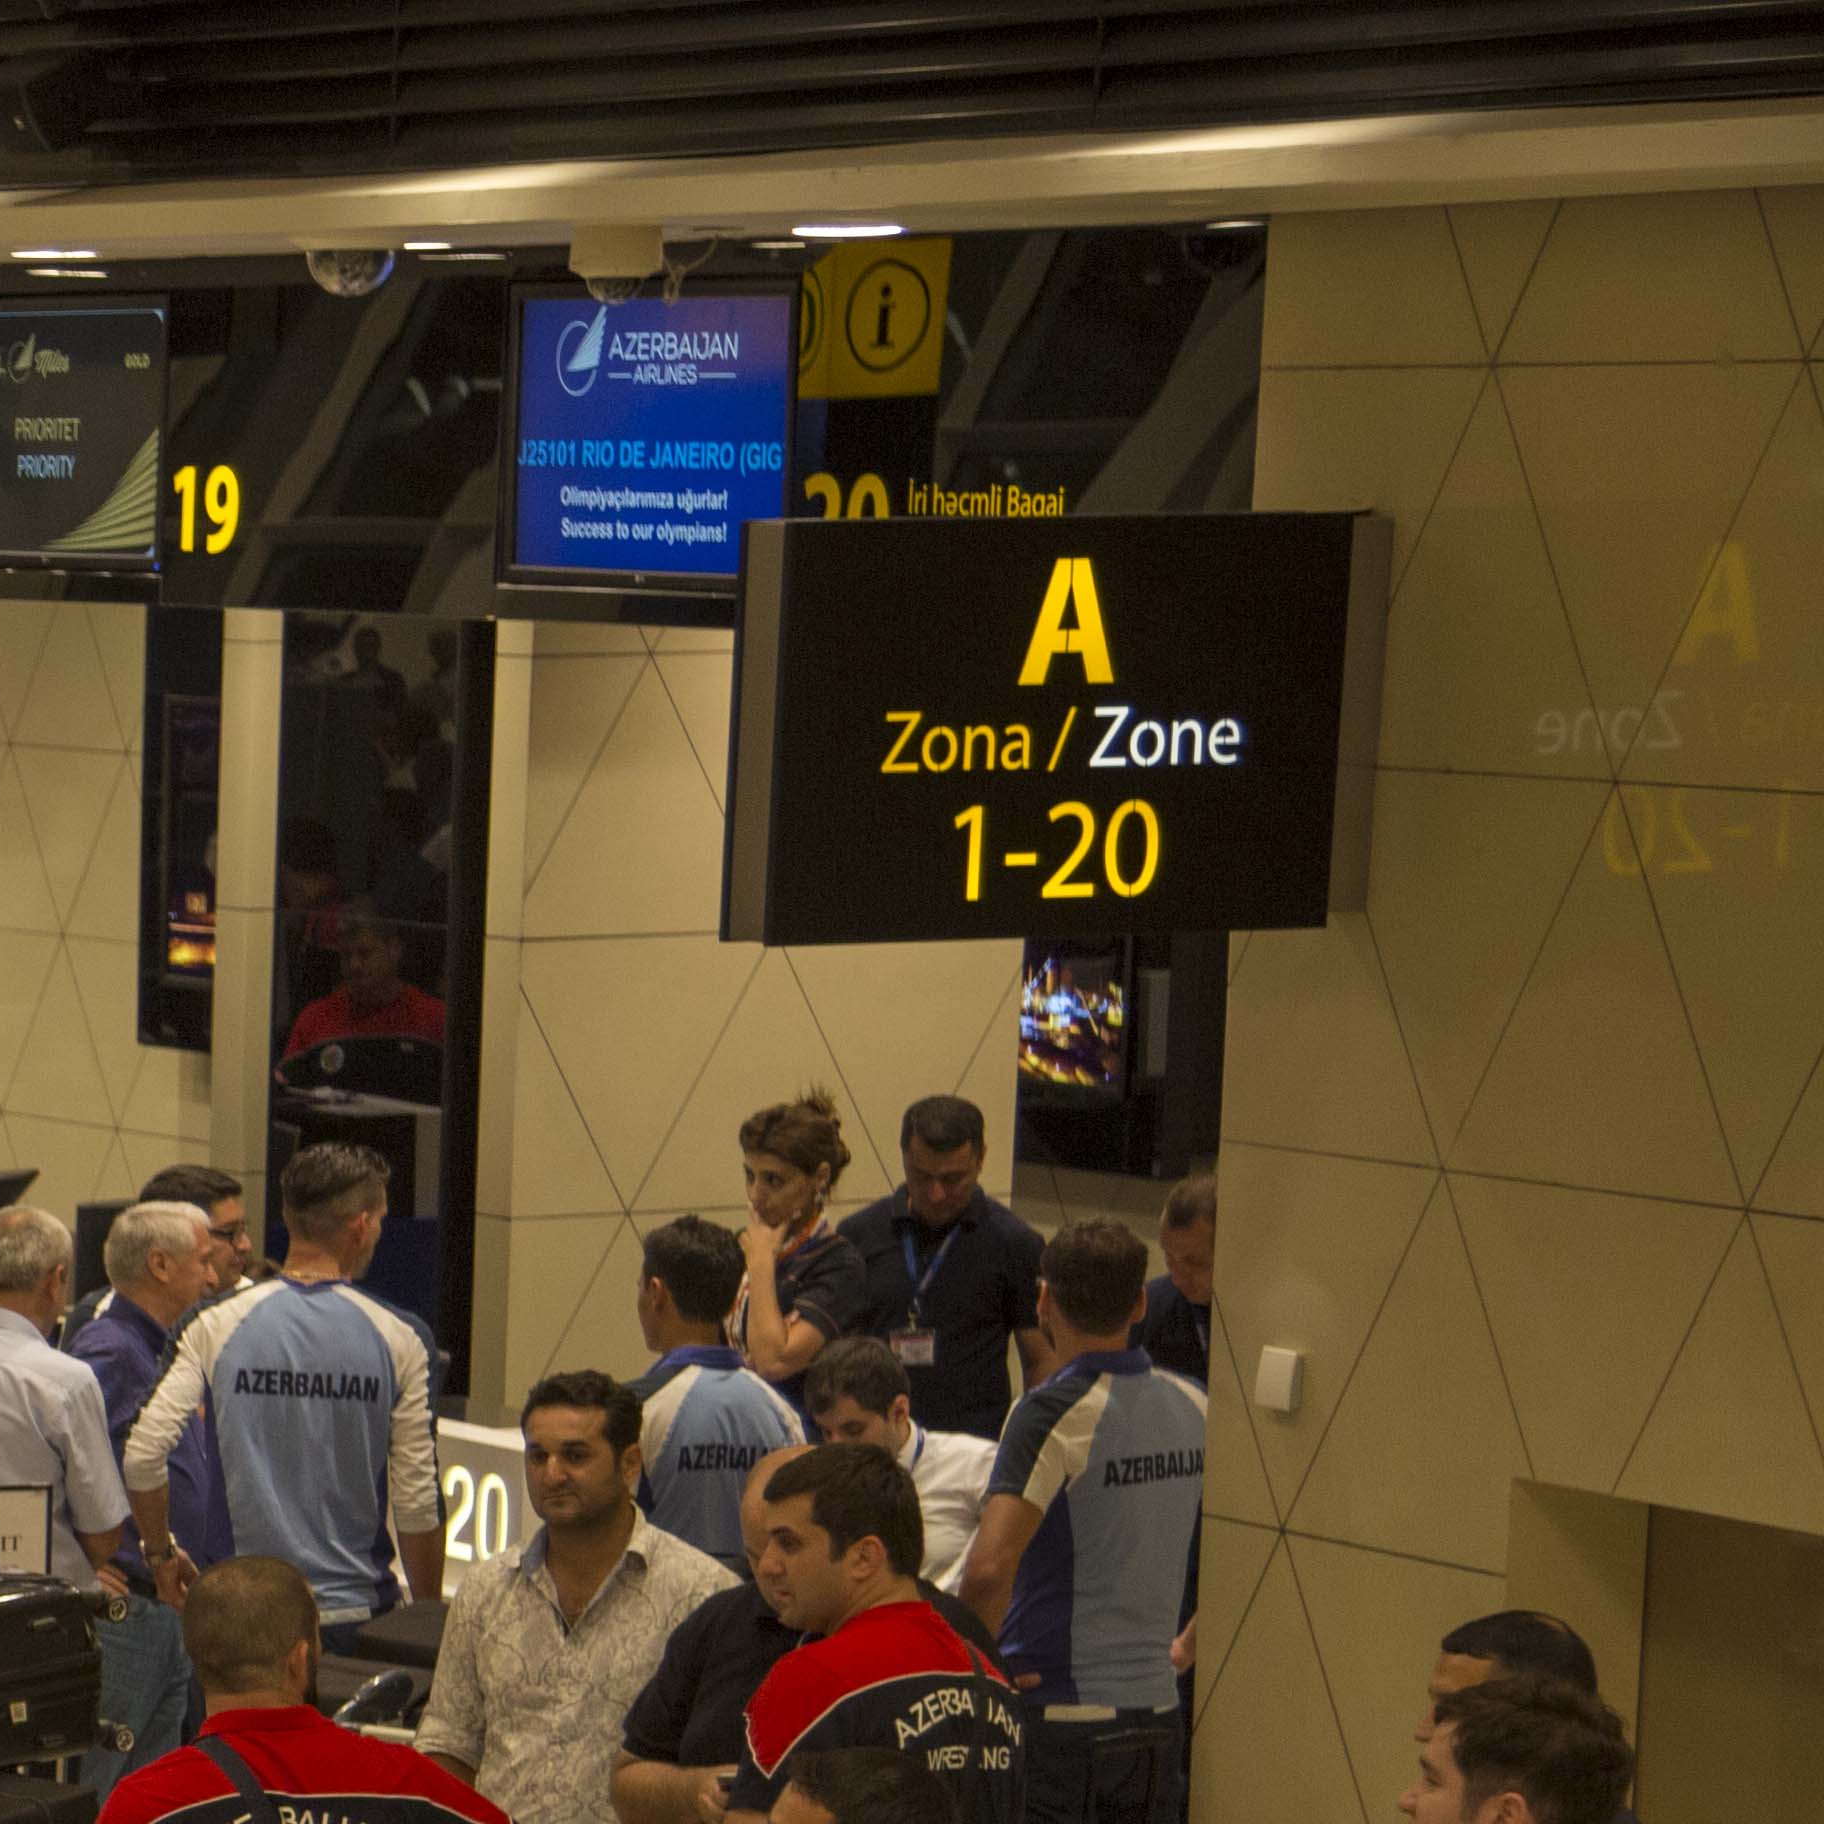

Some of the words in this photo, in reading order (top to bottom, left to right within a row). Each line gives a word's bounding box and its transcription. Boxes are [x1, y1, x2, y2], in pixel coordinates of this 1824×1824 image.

[608, 331, 738, 361] AZERBAIJAN
[632, 364, 698, 385] AIRLINES
[14, 417, 81, 441] PRIORITET
[17, 454, 76, 479] PRIORITY
[582, 440, 614, 467] RIO
[619, 441, 645, 468] DE
[650, 441, 734, 470] JANEIRO
[172, 463, 241, 555] 19
[560, 518, 613, 540] Success
[616, 520, 628, 540] to
[632, 523, 652, 540] our
[656, 520, 728, 545] olympians!
[1018, 557, 1115, 687] A
[880, 710, 1032, 774] Zona
[1088, 704, 1241, 767] Zone
[953, 798, 1161, 902] 1-20
[234, 1368, 380, 1402] AZERBAIJAN
[1103, 1447, 1205, 1488] AZERBAIJA
[443, 1464, 510, 1562] 20
